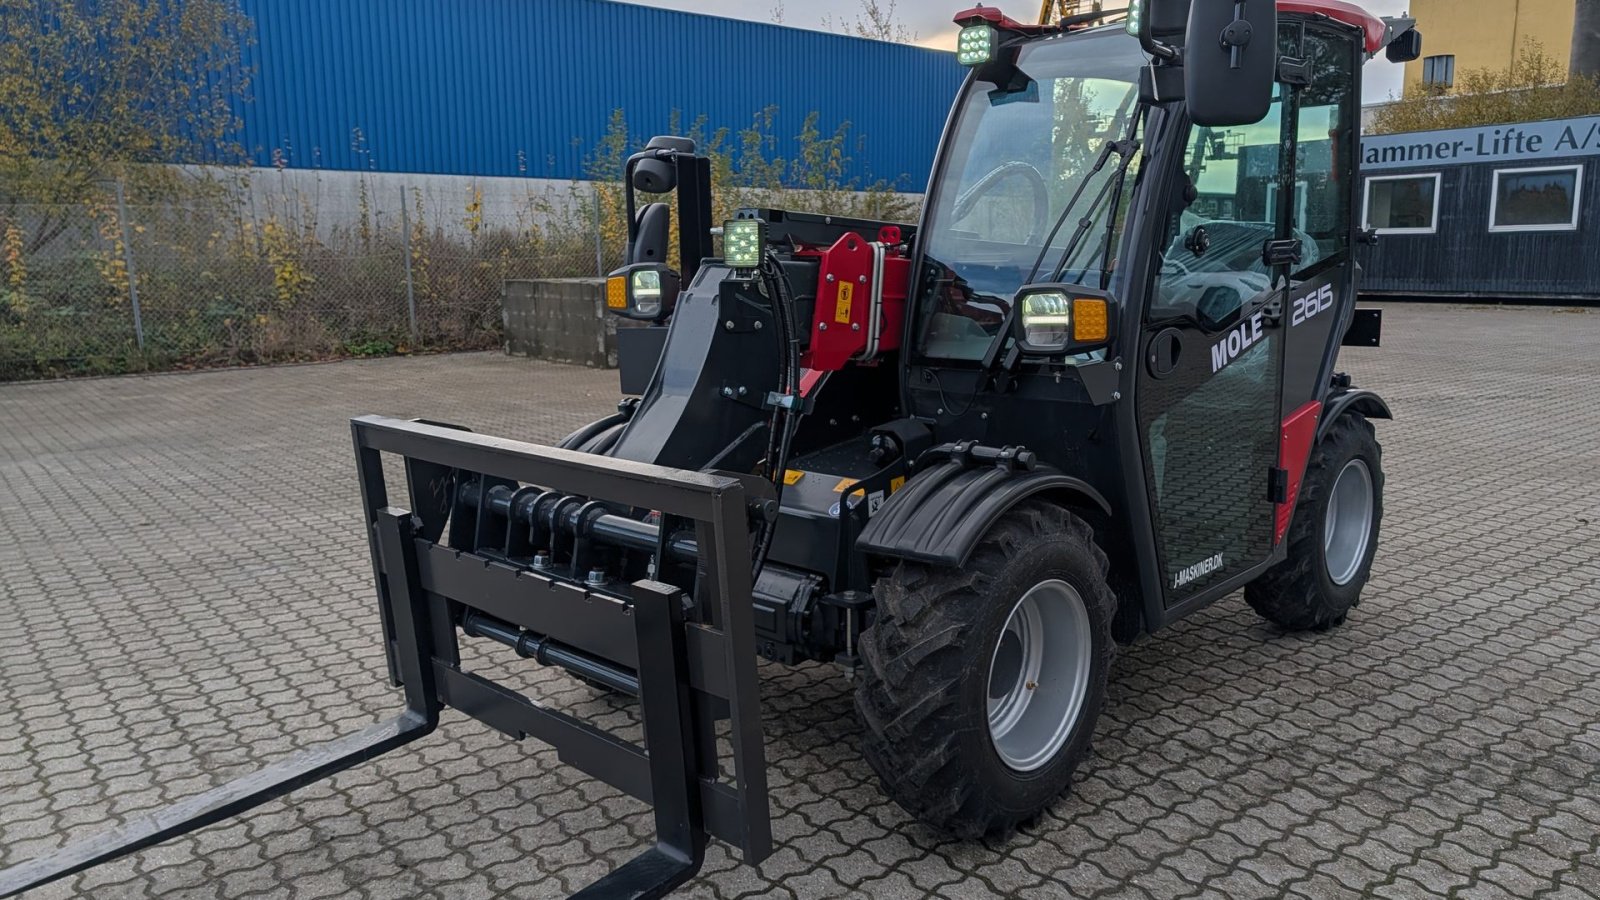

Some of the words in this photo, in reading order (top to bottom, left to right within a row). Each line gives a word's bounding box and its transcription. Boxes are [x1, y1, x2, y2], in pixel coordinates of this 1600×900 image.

[1554, 122, 1600, 151] A/
[1211, 311, 1263, 373] MOLE
[1292, 283, 1333, 327] 2615
[1173, 552, 1223, 588] J-MASKINER.DK
